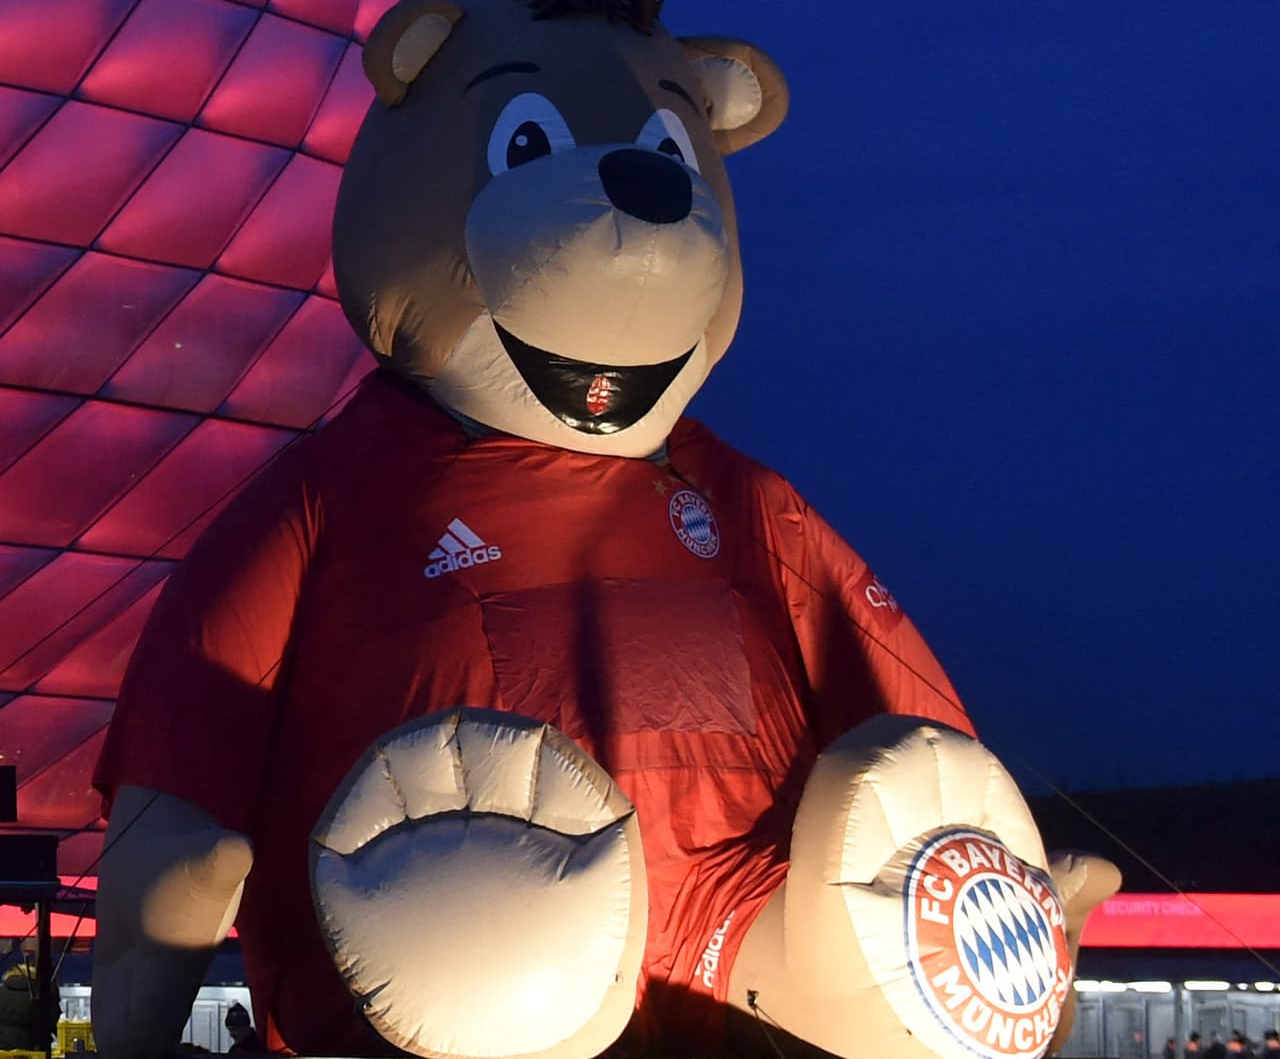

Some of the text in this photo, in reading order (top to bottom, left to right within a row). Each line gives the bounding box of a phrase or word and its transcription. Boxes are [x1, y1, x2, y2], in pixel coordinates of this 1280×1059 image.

[424, 546, 502, 579] adidas
[921, 874, 954, 925] FC
[1103, 900, 1159, 916] SECURITY
